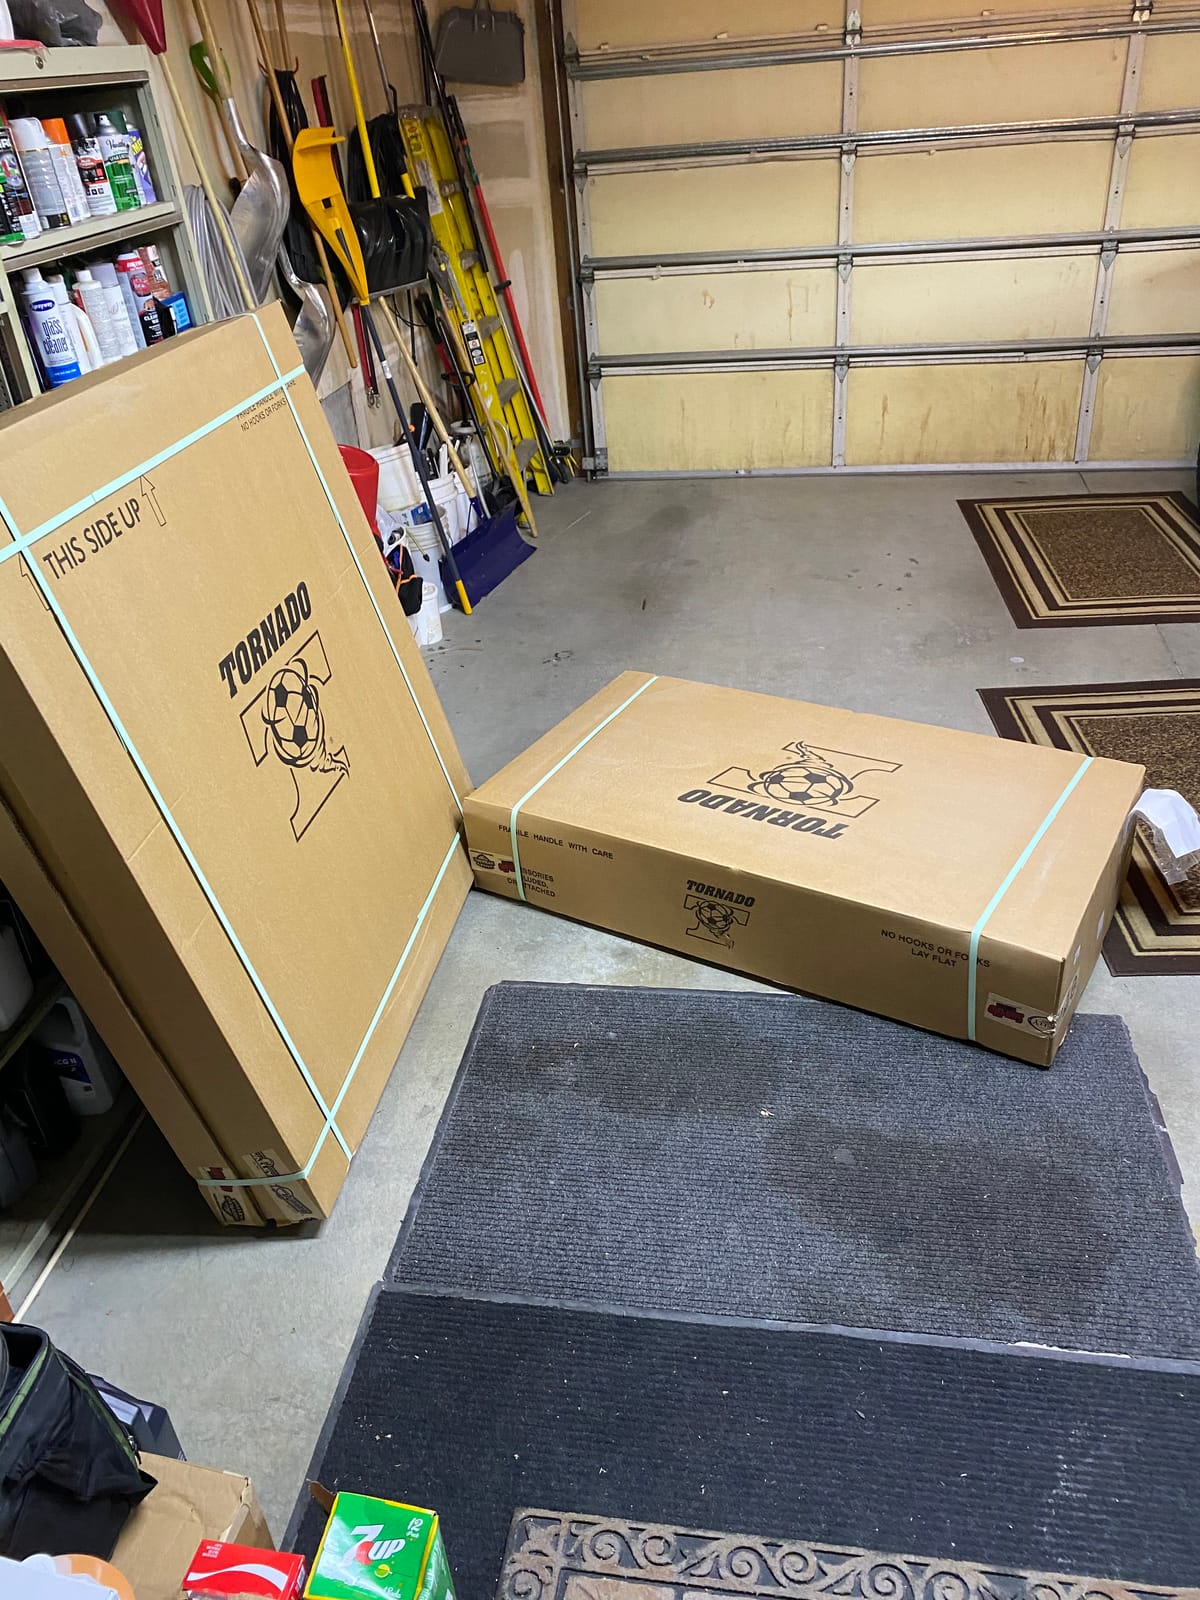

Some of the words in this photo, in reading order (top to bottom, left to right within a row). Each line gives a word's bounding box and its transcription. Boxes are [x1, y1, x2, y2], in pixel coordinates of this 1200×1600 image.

[42, 319, 63, 340] glass
[43, 337, 68, 355] cleaner
[241, 421, 250, 431] NO
[249, 411, 266, 426] HOOKS
[265, 406, 273, 417] OR
[271, 397, 287, 413] FORKS
[42, 536, 86, 579] THIS
[83, 512, 123, 554] SIDE
[118, 498, 141, 529] UP
[218, 581, 312, 699] TORNADO
[677, 789, 850, 840] TORNADO
[498, 824, 529, 838] FRAILE
[533, 834, 563, 846] HANDLE
[568, 842, 588, 853] WITH
[591, 848, 614, 860] CARE
[686, 880, 756, 907] TORNADO
[881, 929, 896, 939] NO
[898, 934, 935, 951] HOOKS
[937, 946, 952, 957] OR
[954, 951, 991, 968] FOKS
[911, 948, 930, 960] LAY
[932, 954, 957, 968] FLAT
[407, 1517, 424, 1533] 12
